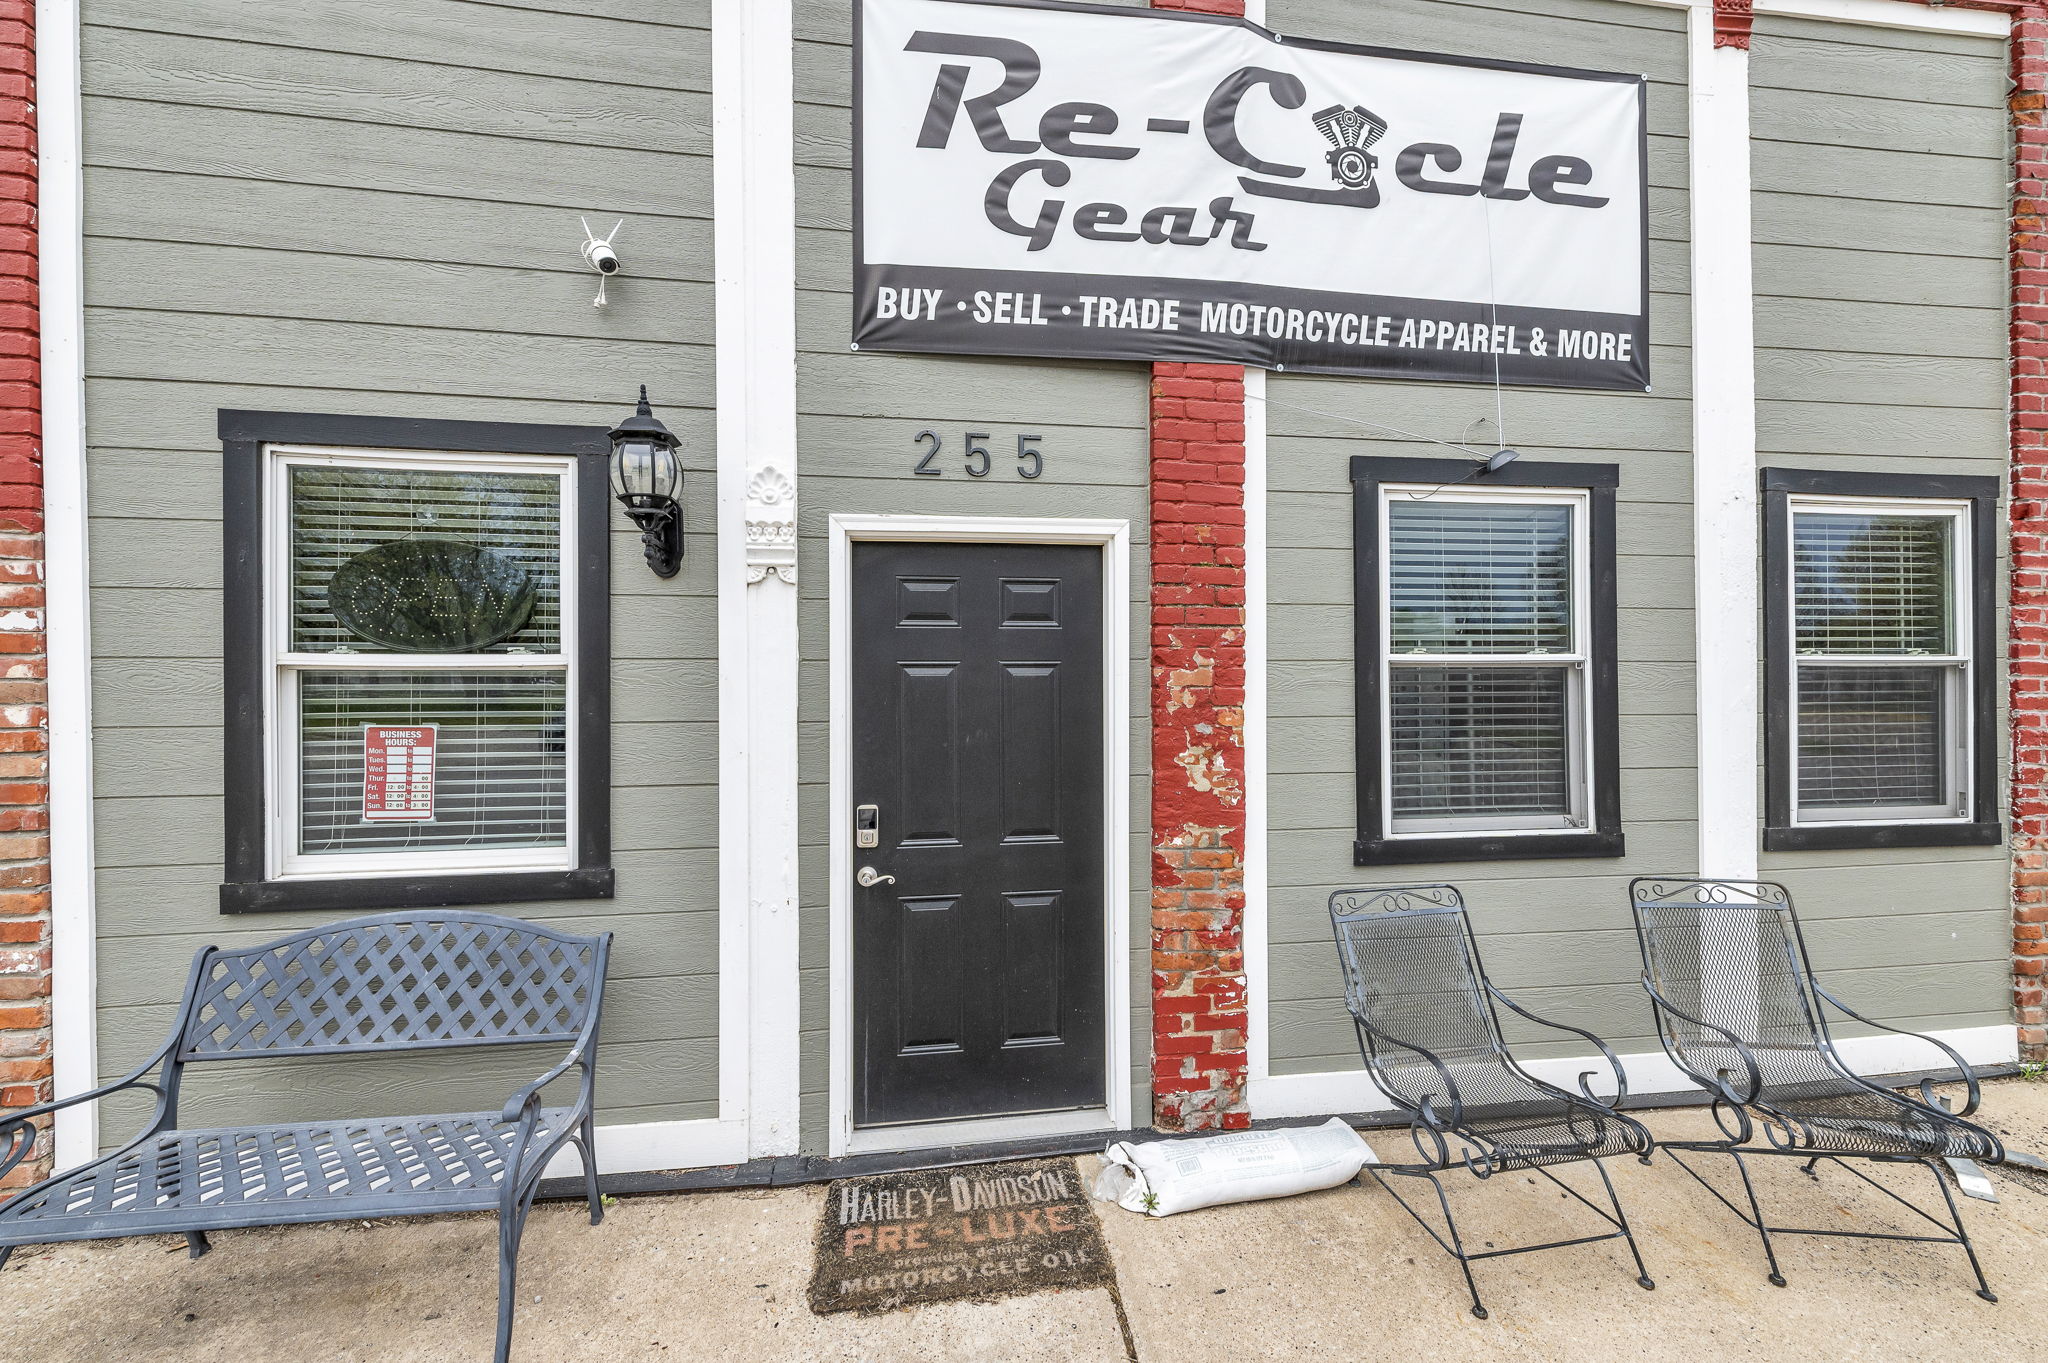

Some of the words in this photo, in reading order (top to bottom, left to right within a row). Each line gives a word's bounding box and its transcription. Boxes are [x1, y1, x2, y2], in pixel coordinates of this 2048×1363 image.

[984, 158, 1268, 251] Gear
[876, 286, 943, 321] BUY
[972, 290, 1048, 326] SELL
[1079, 295, 1180, 331] TRADE
[1200, 301, 1392, 349] MOTORCYCLE
[1399, 317, 1521, 357] APPAREL
[1528, 327, 1549, 357] &
[1556, 327, 1633, 363] MORE
[914, 429, 1043, 479] 255
[351, 576, 512, 618] OPEN
[379, 730, 422, 738] BUSINESS
[839, 1170, 1070, 1225] HARLEY-DAVIDSON
[844, 1206, 1076, 1257] PRE-LUXE
[840, 1257, 1031, 1295] MOTORCYCLE
